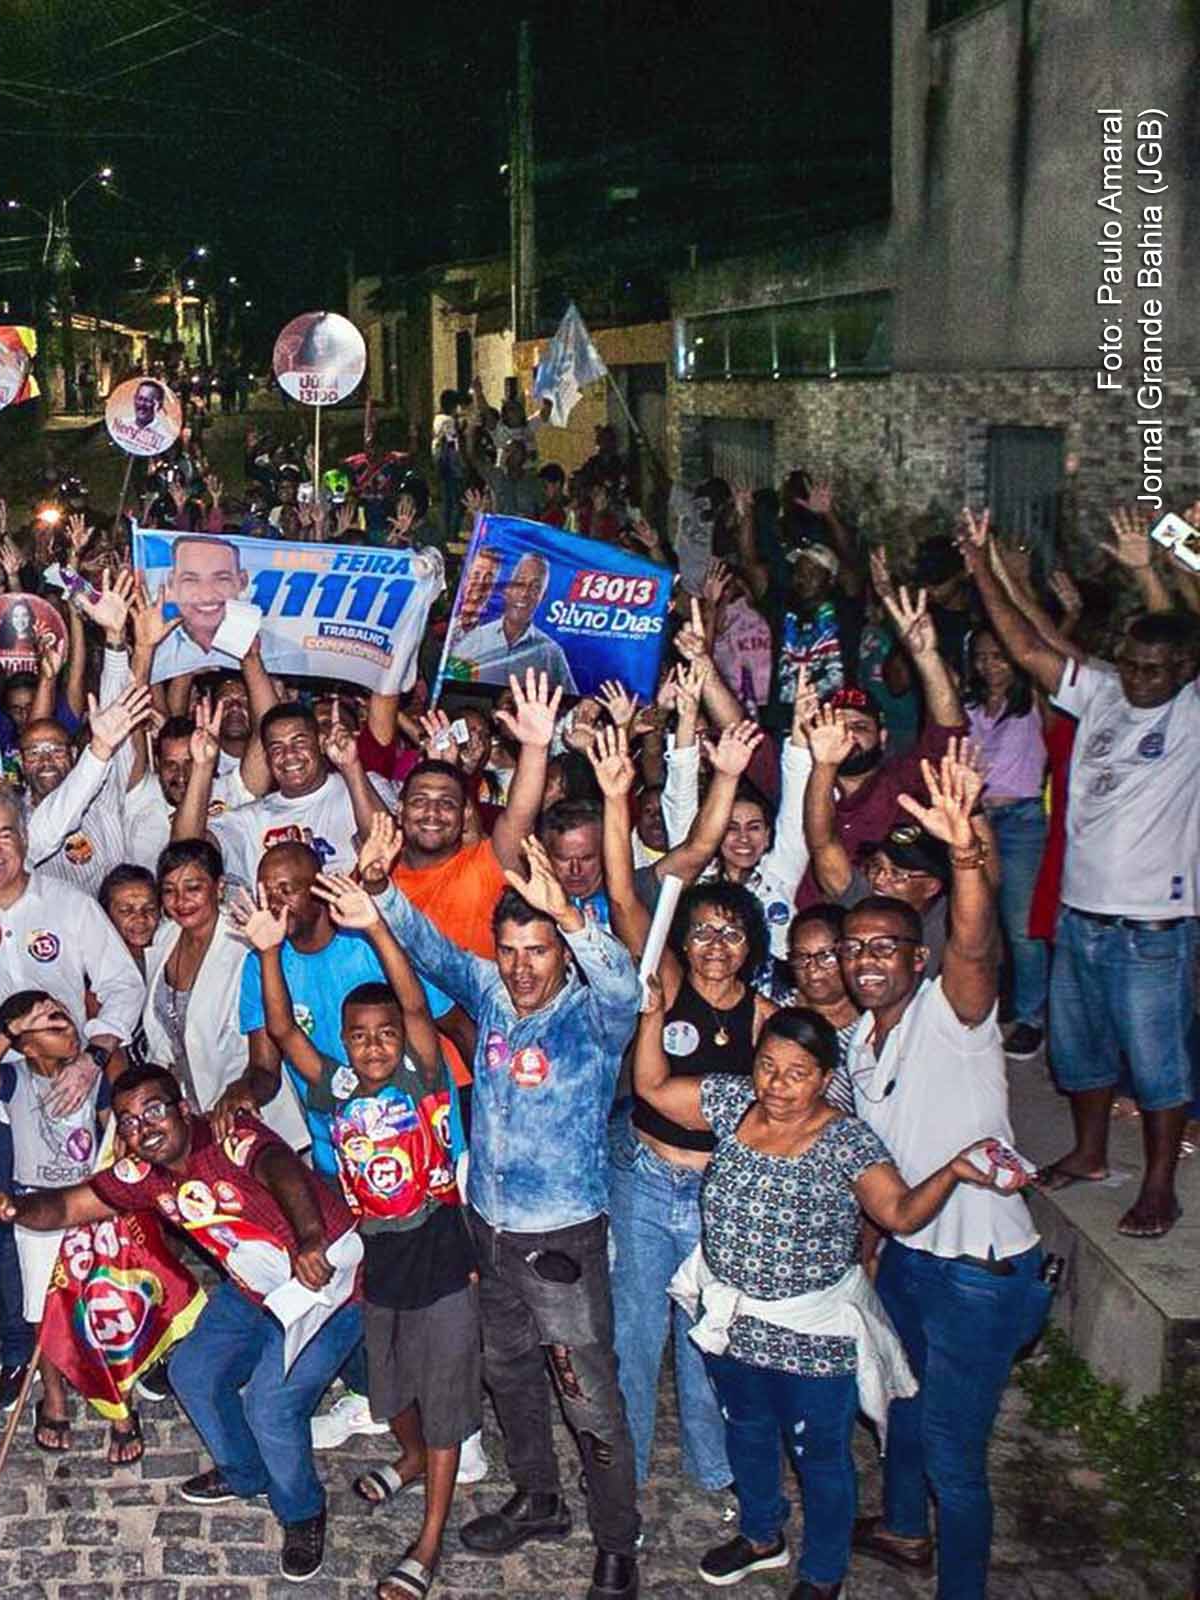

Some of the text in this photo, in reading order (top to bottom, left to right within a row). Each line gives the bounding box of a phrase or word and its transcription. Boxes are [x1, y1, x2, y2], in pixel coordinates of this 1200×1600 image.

[332, 552, 410, 575] FEIRA
[251, 570, 416, 629] 11111
[578, 574, 653, 605] 13013
[323, 624, 386, 645] TRABALHO
[610, 608, 664, 633] Dias
[87, 1288, 137, 1341] 13
